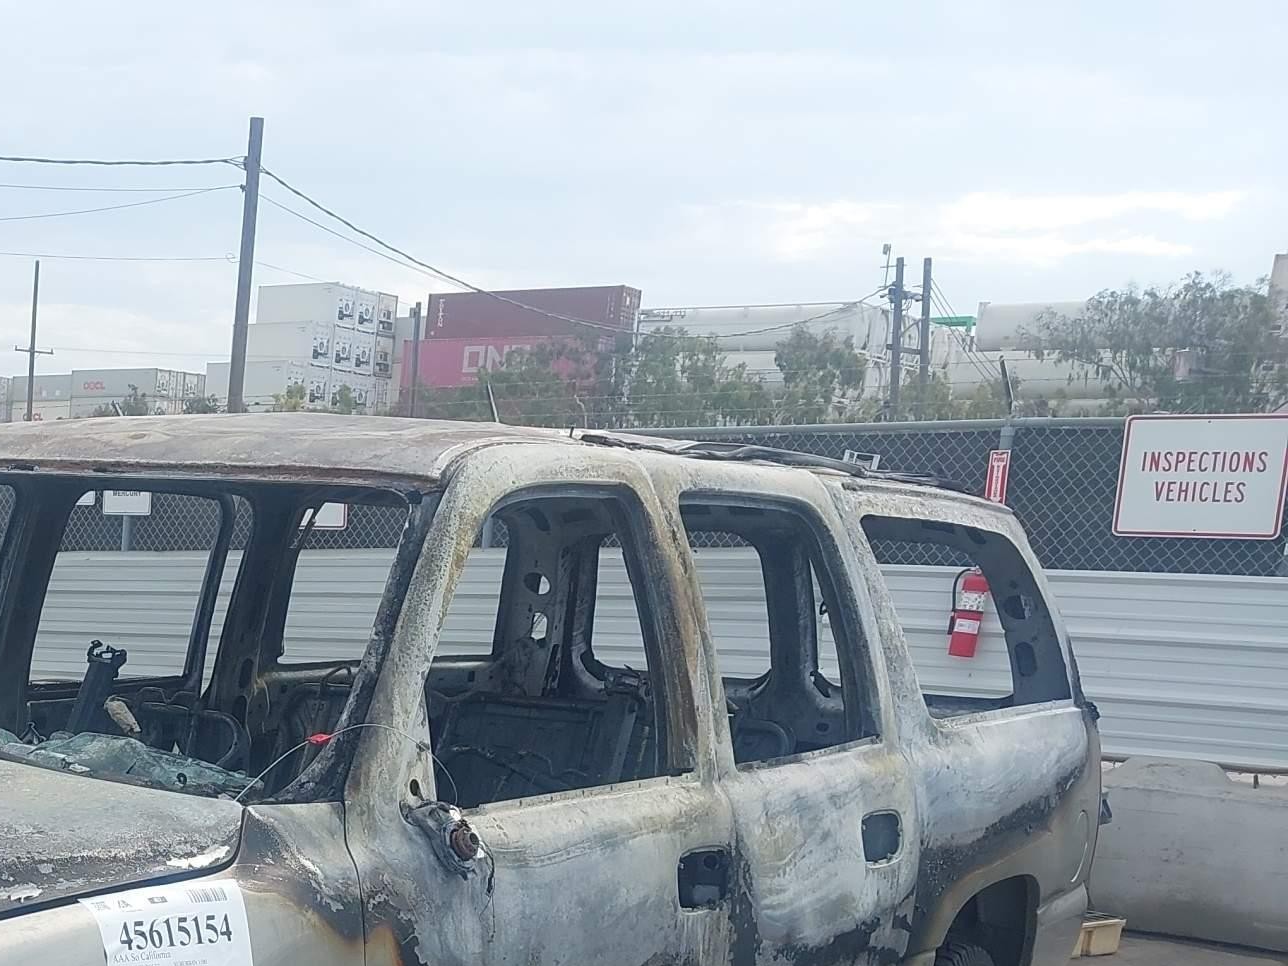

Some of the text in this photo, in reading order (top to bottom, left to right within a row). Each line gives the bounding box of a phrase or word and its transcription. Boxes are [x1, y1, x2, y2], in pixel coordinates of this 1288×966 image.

[23, 412, 43, 421] OCL
[1141, 451, 1269, 473] INSPECTIONS
[1154, 481, 1246, 503] VEHICLES
[119, 913, 233, 951] 45615154
